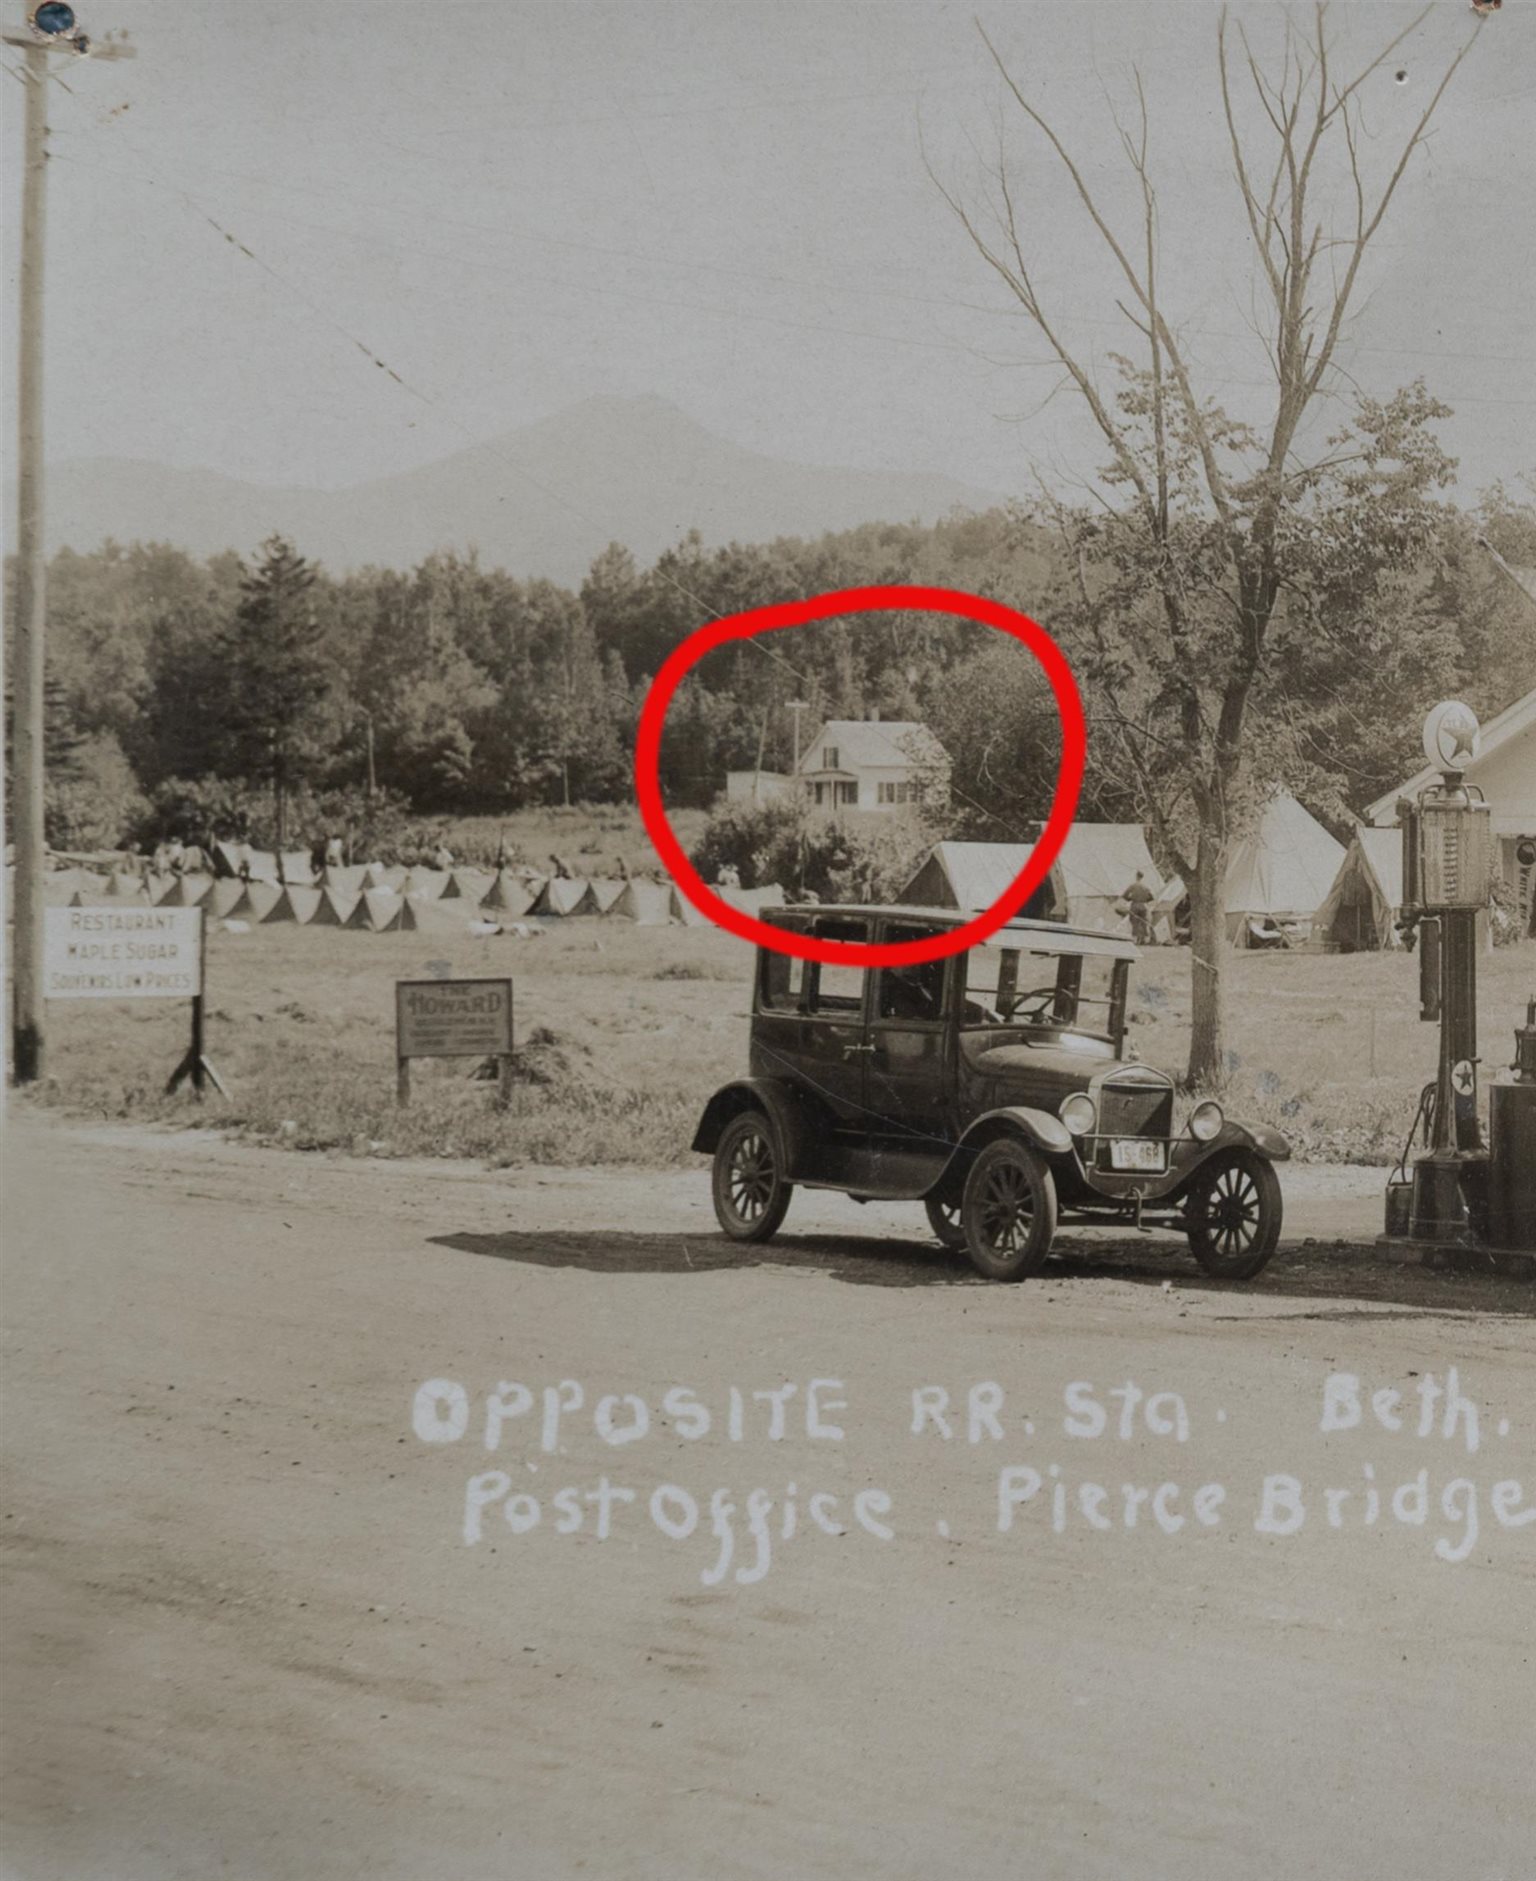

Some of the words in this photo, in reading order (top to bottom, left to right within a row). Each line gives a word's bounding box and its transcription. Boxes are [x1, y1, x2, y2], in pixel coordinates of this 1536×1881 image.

[71, 912, 176, 931] RESTAURANT
[67, 943, 121, 960] MAPLE
[125, 941, 179, 960] SUGAR
